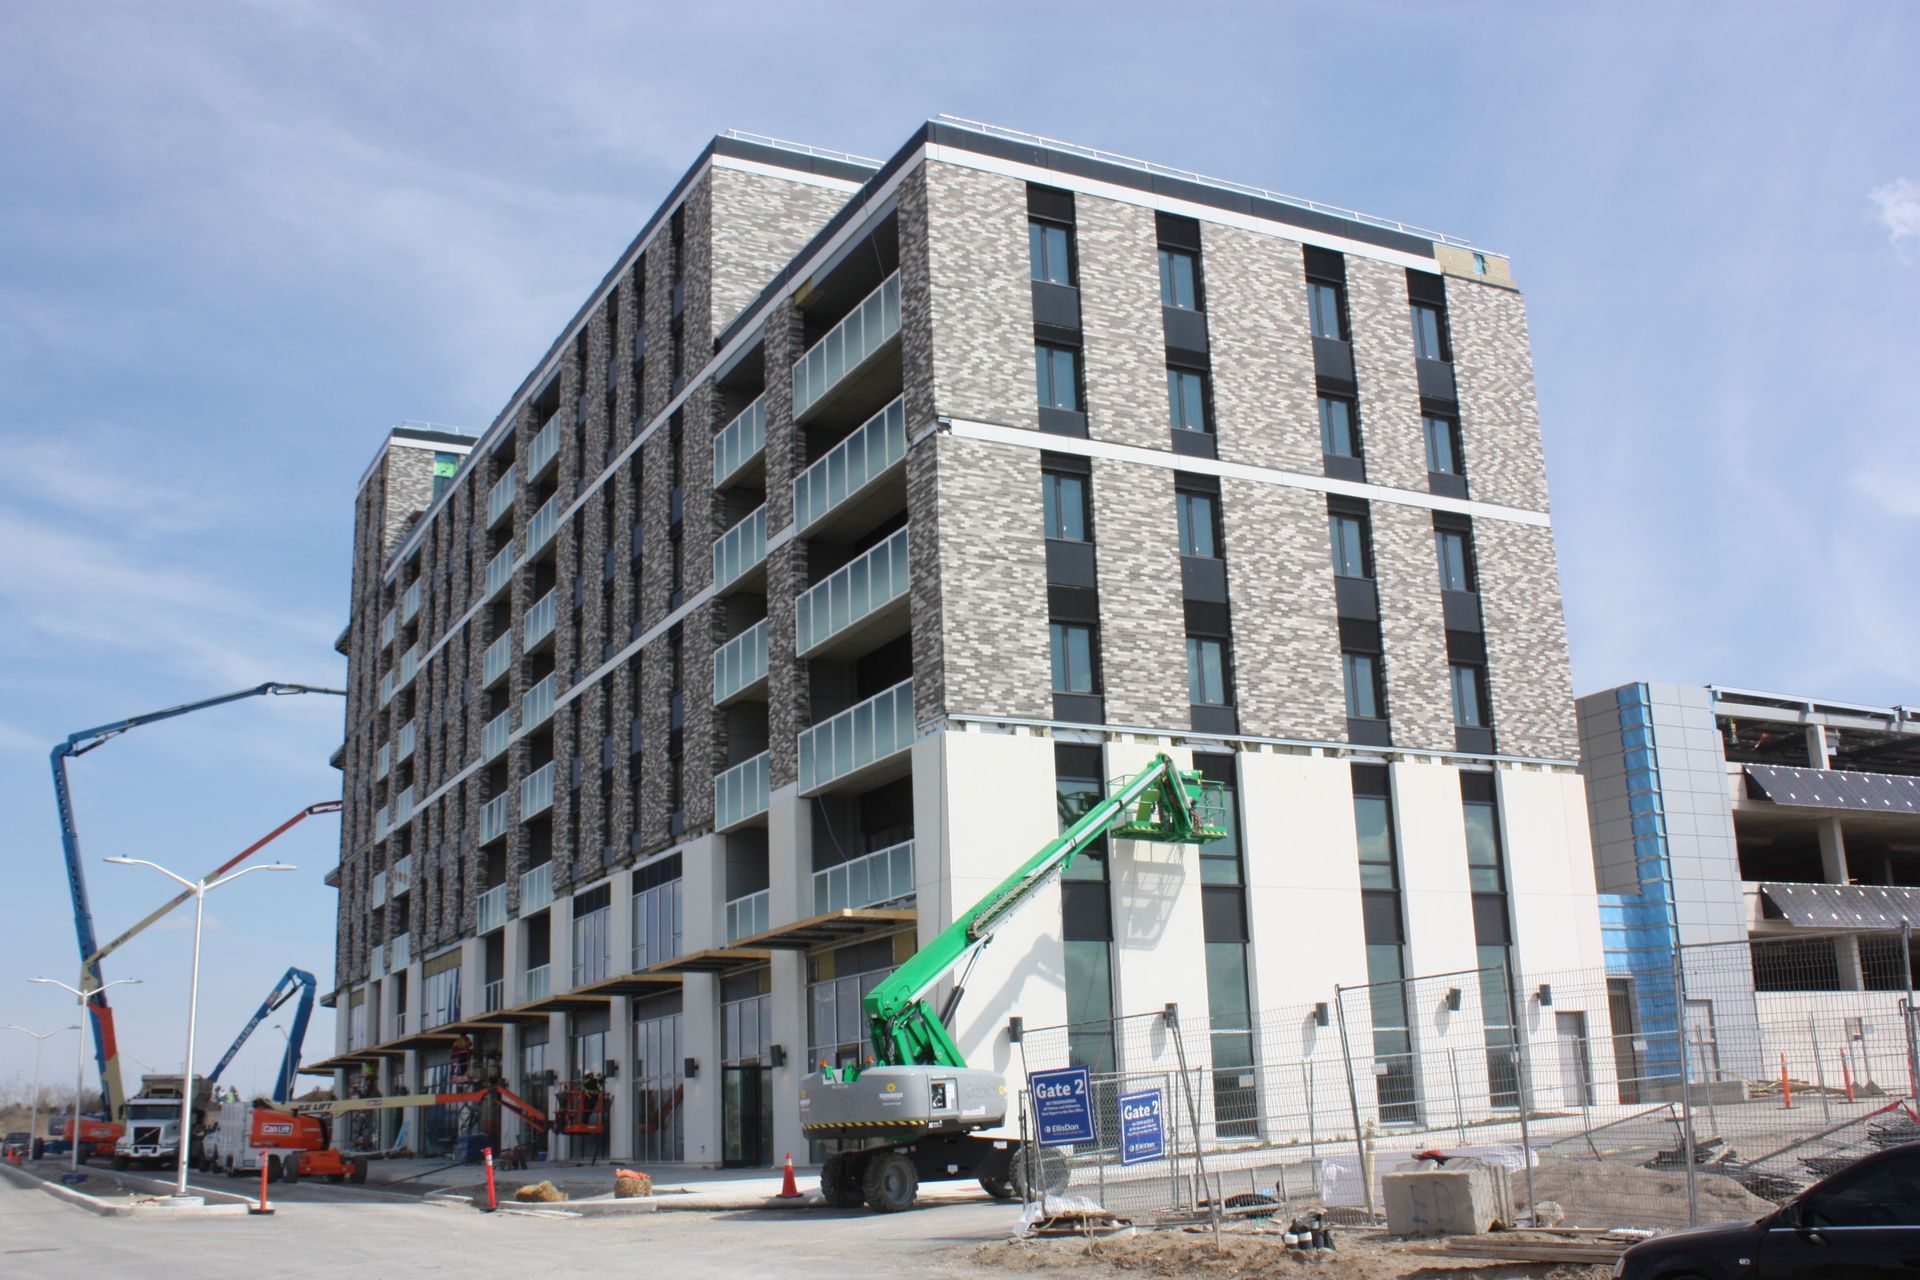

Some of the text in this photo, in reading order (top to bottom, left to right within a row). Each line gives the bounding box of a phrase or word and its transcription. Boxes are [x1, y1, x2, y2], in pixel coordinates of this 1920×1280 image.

[1036, 1079, 1085, 1099] Gate 2
[1124, 1100, 1159, 1120] Gate 2
